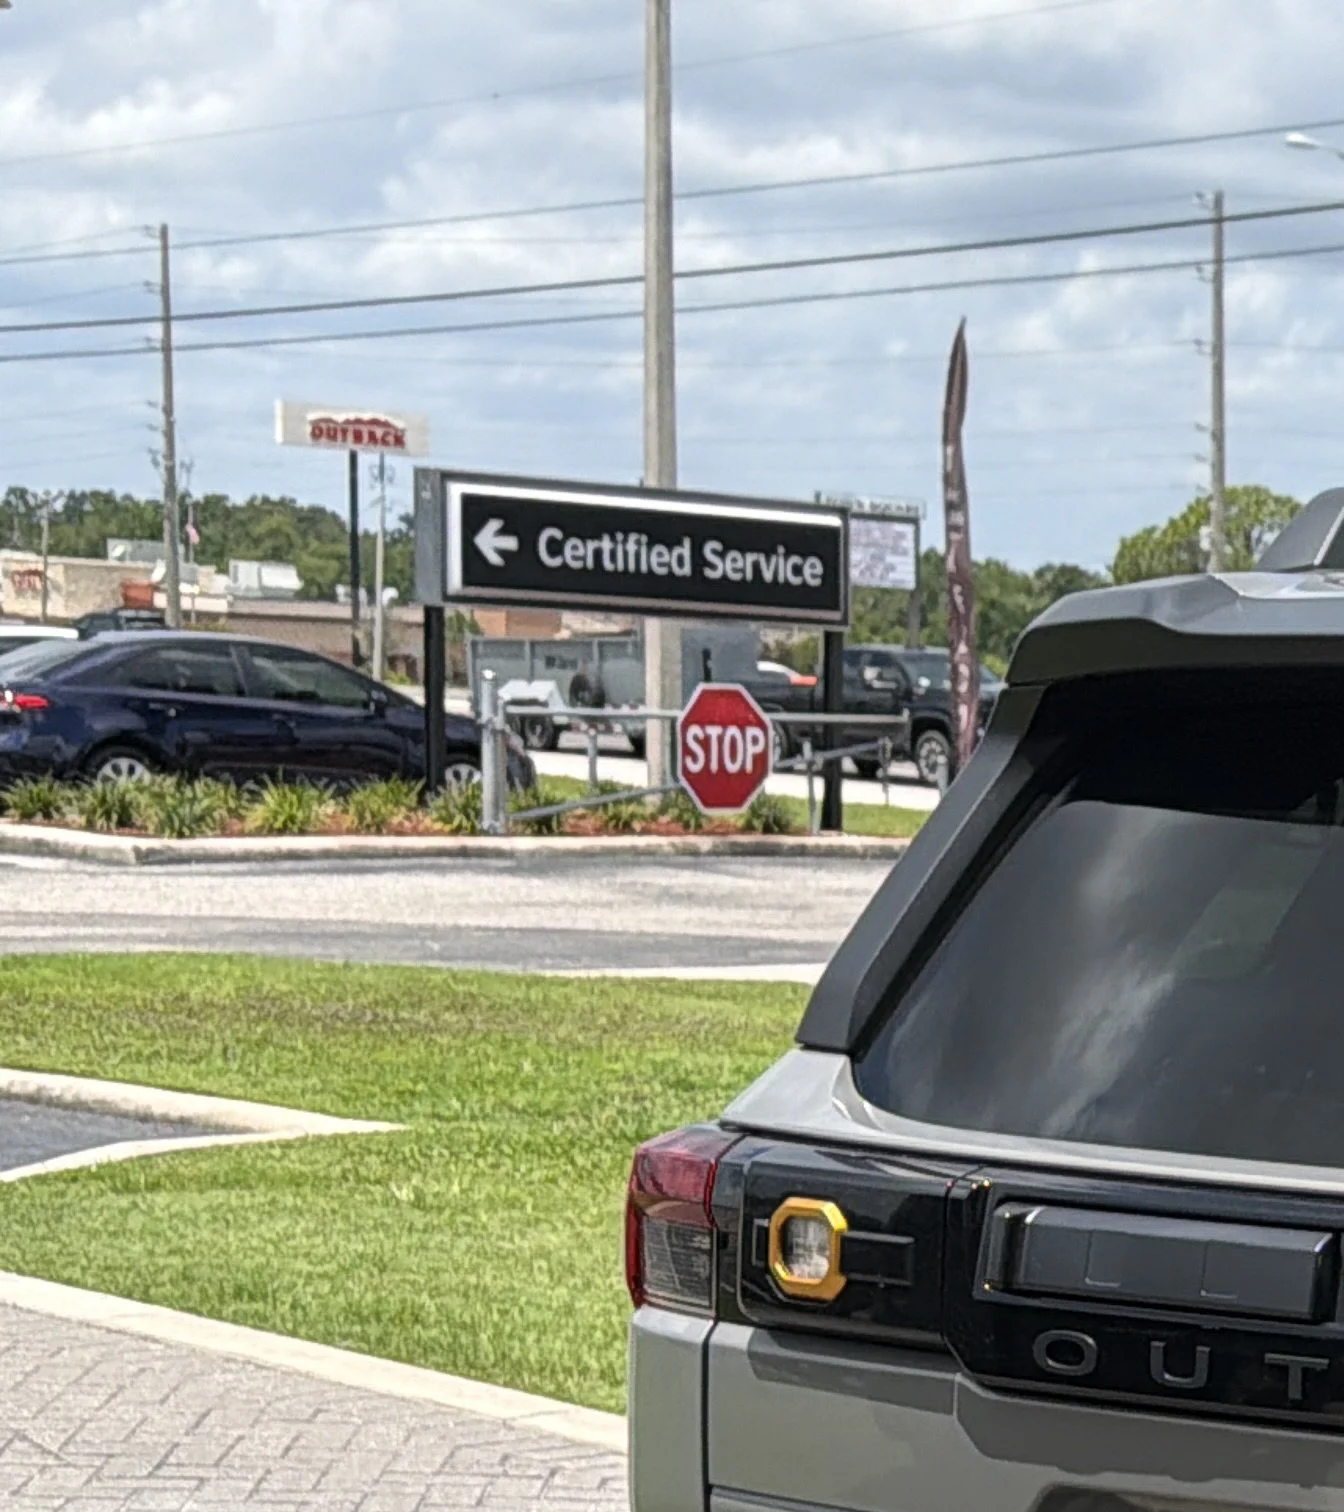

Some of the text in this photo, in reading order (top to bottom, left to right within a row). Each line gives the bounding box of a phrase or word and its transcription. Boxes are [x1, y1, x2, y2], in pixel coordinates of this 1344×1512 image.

[310, 422, 405, 448] OUTBACK
[537, 526, 692, 577] Certified
[702, 540, 824, 588] Service
[684, 723, 766, 775] STOP
